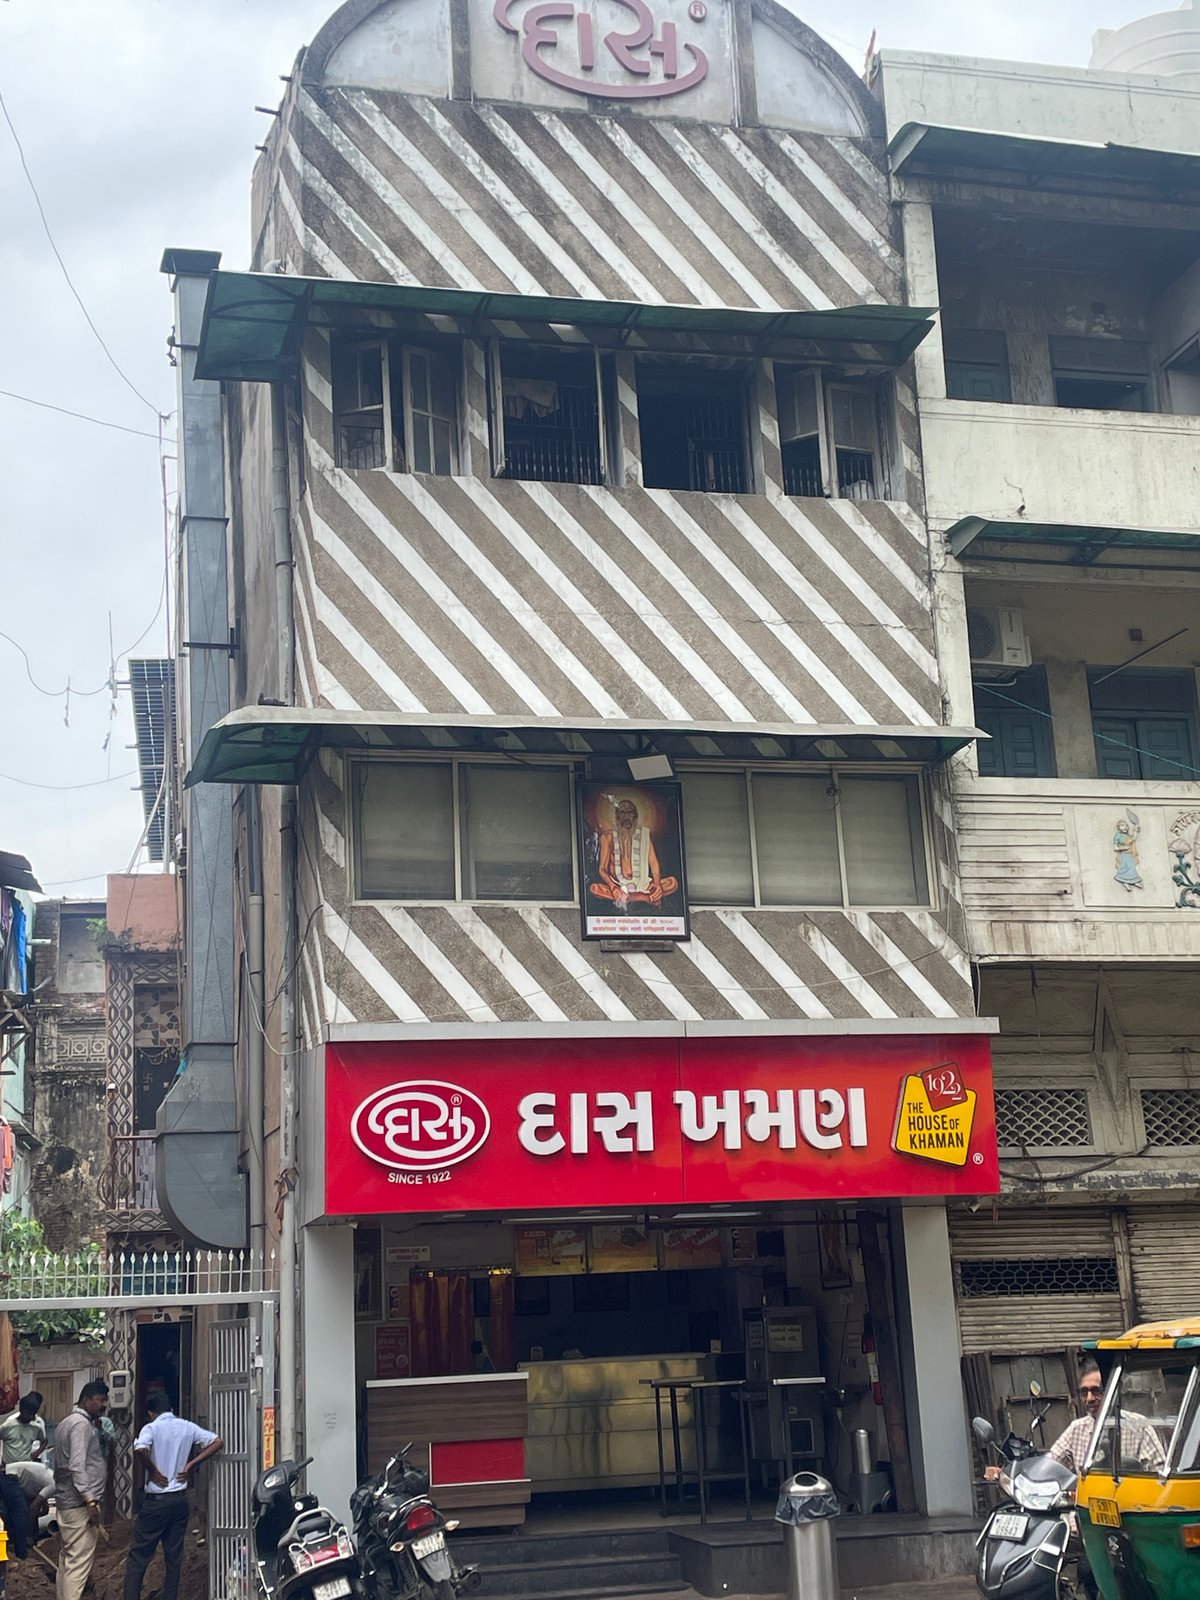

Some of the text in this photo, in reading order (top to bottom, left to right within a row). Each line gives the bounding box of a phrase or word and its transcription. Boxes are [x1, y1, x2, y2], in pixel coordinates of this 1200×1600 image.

[907, 1102, 924, 1114] THE
[517, 1086, 868, 1157] દાસ ખમણ
[908, 1115, 960, 1131] HOUSE OF
[909, 1132, 964, 1150] KHAMAN
[387, 1170, 452, 1185] SINCE 1922
